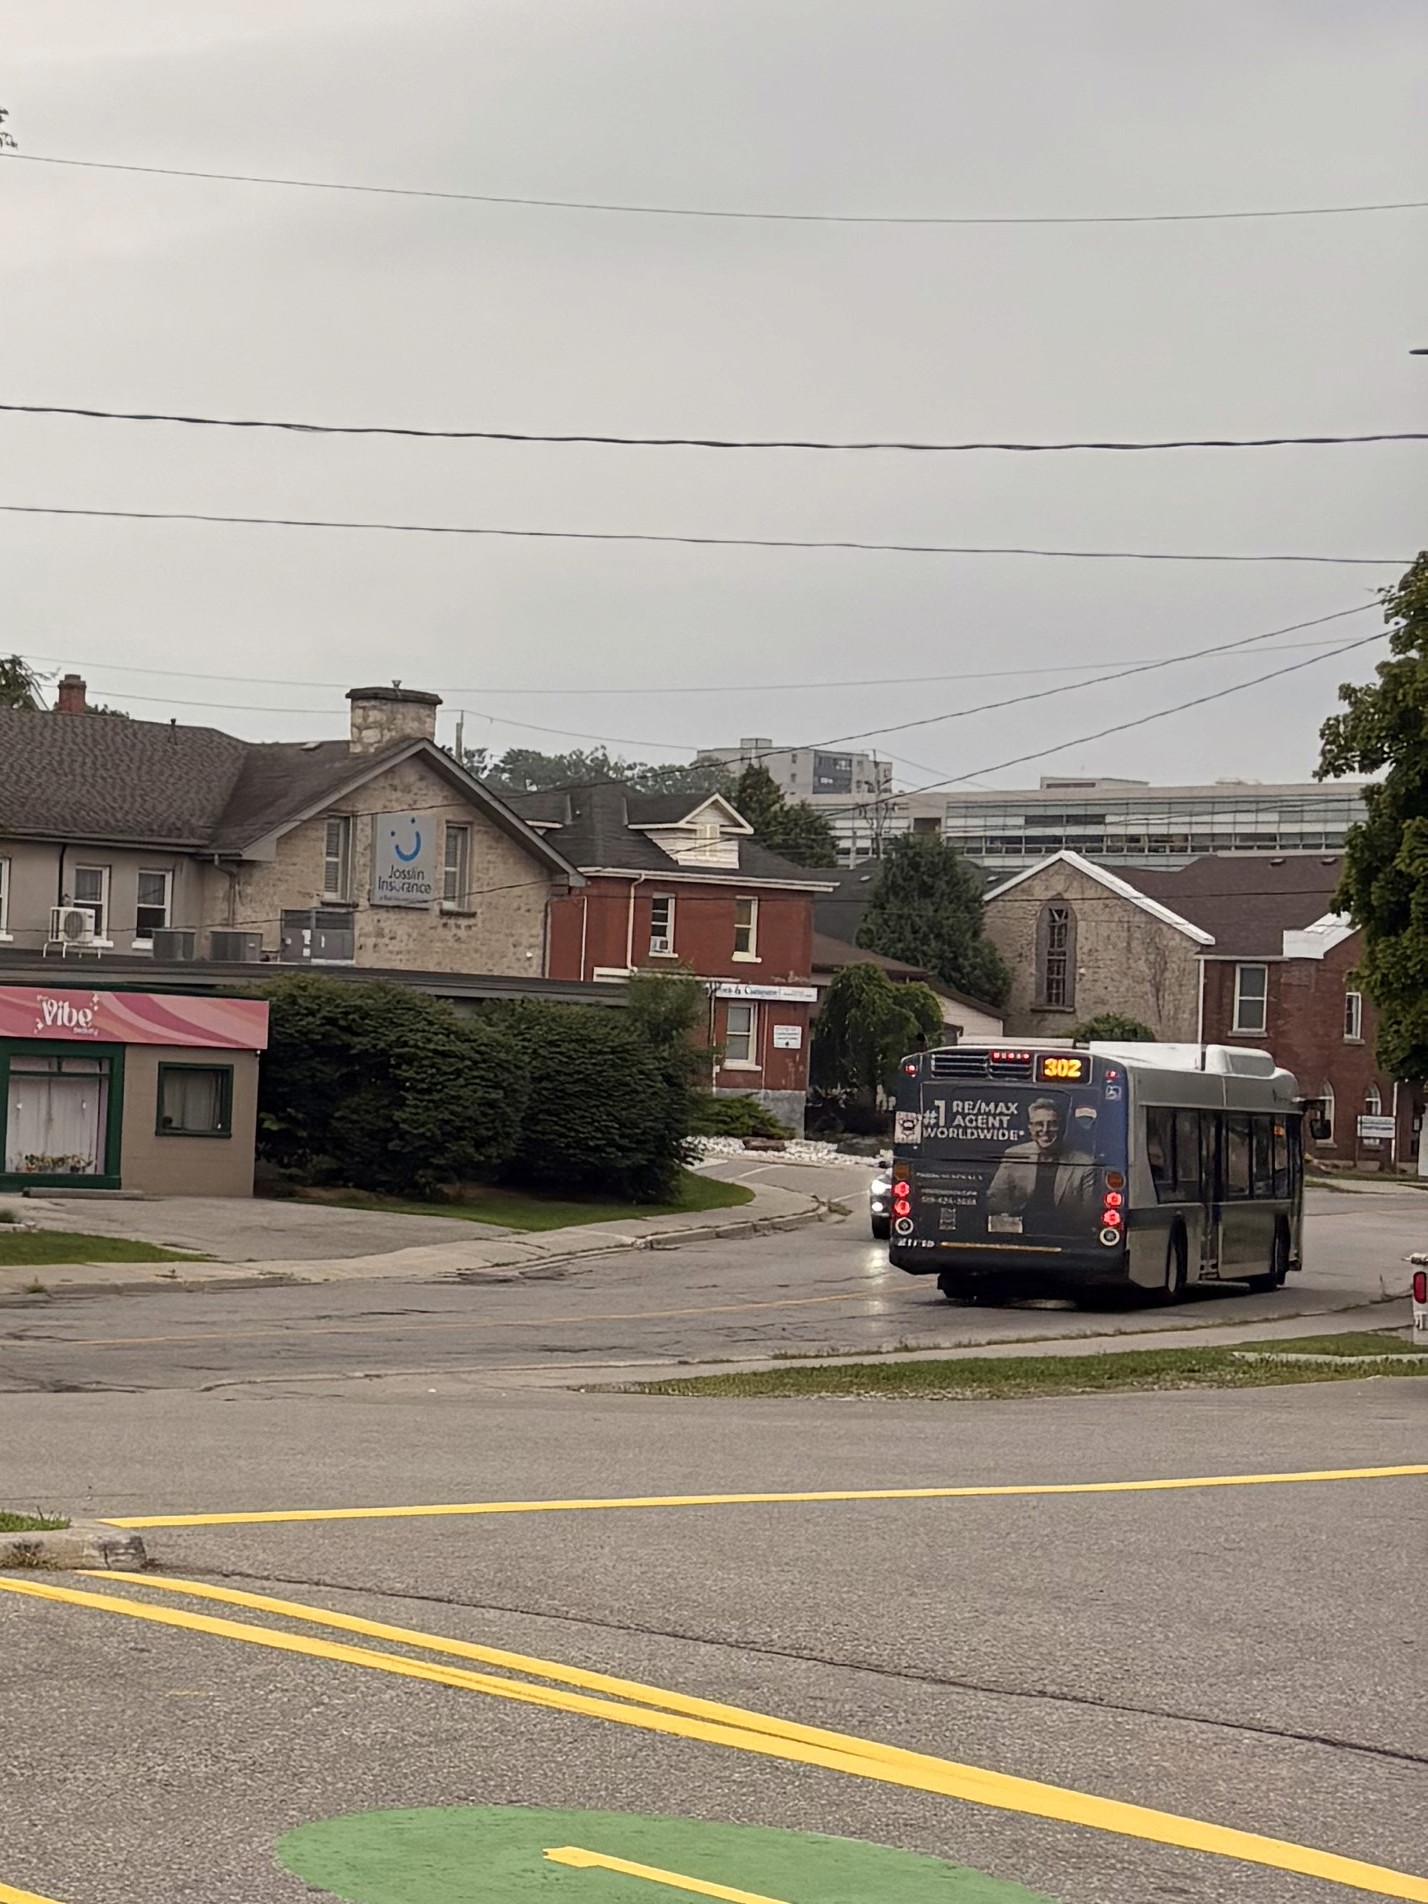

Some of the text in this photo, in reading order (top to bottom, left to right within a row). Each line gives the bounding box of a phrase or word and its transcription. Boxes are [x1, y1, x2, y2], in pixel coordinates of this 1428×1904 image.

[389, 864, 425, 881] Josslin
[378, 876, 432, 895] Insurance
[43, 999, 93, 1027] Vibe
[1044, 1058, 1082, 1078] 302
[924, 1099, 1019, 1127] #1 RE/MAX
[952, 1115, 1011, 1128] AGENT
